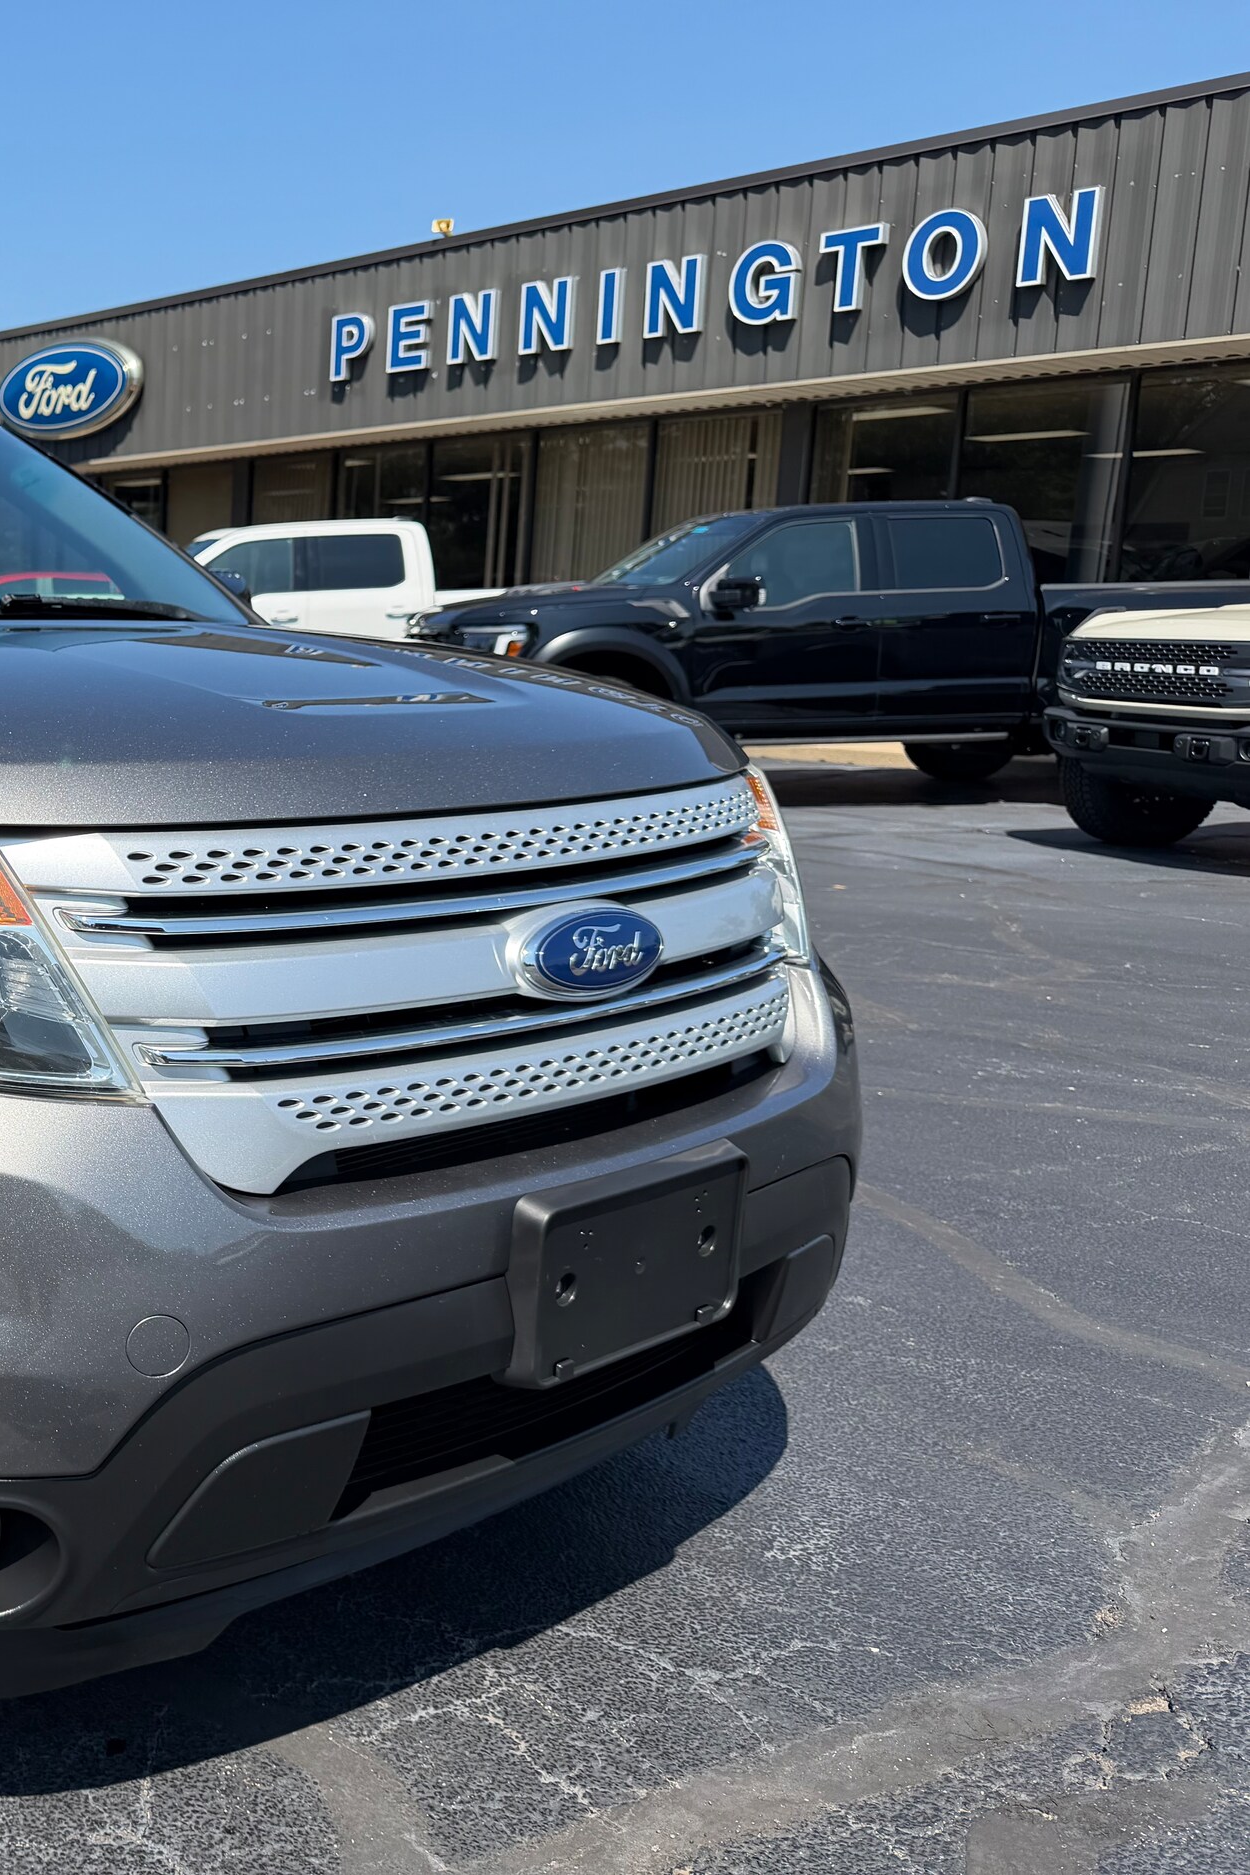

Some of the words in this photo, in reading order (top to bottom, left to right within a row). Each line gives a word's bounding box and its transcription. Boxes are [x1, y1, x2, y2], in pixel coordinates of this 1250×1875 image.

[329, 185, 1104, 382] PENNINGTON
[18, 360, 97, 420] Ford
[1096, 661, 1219, 676] BRONCO
[569, 923, 645, 976] Ford
